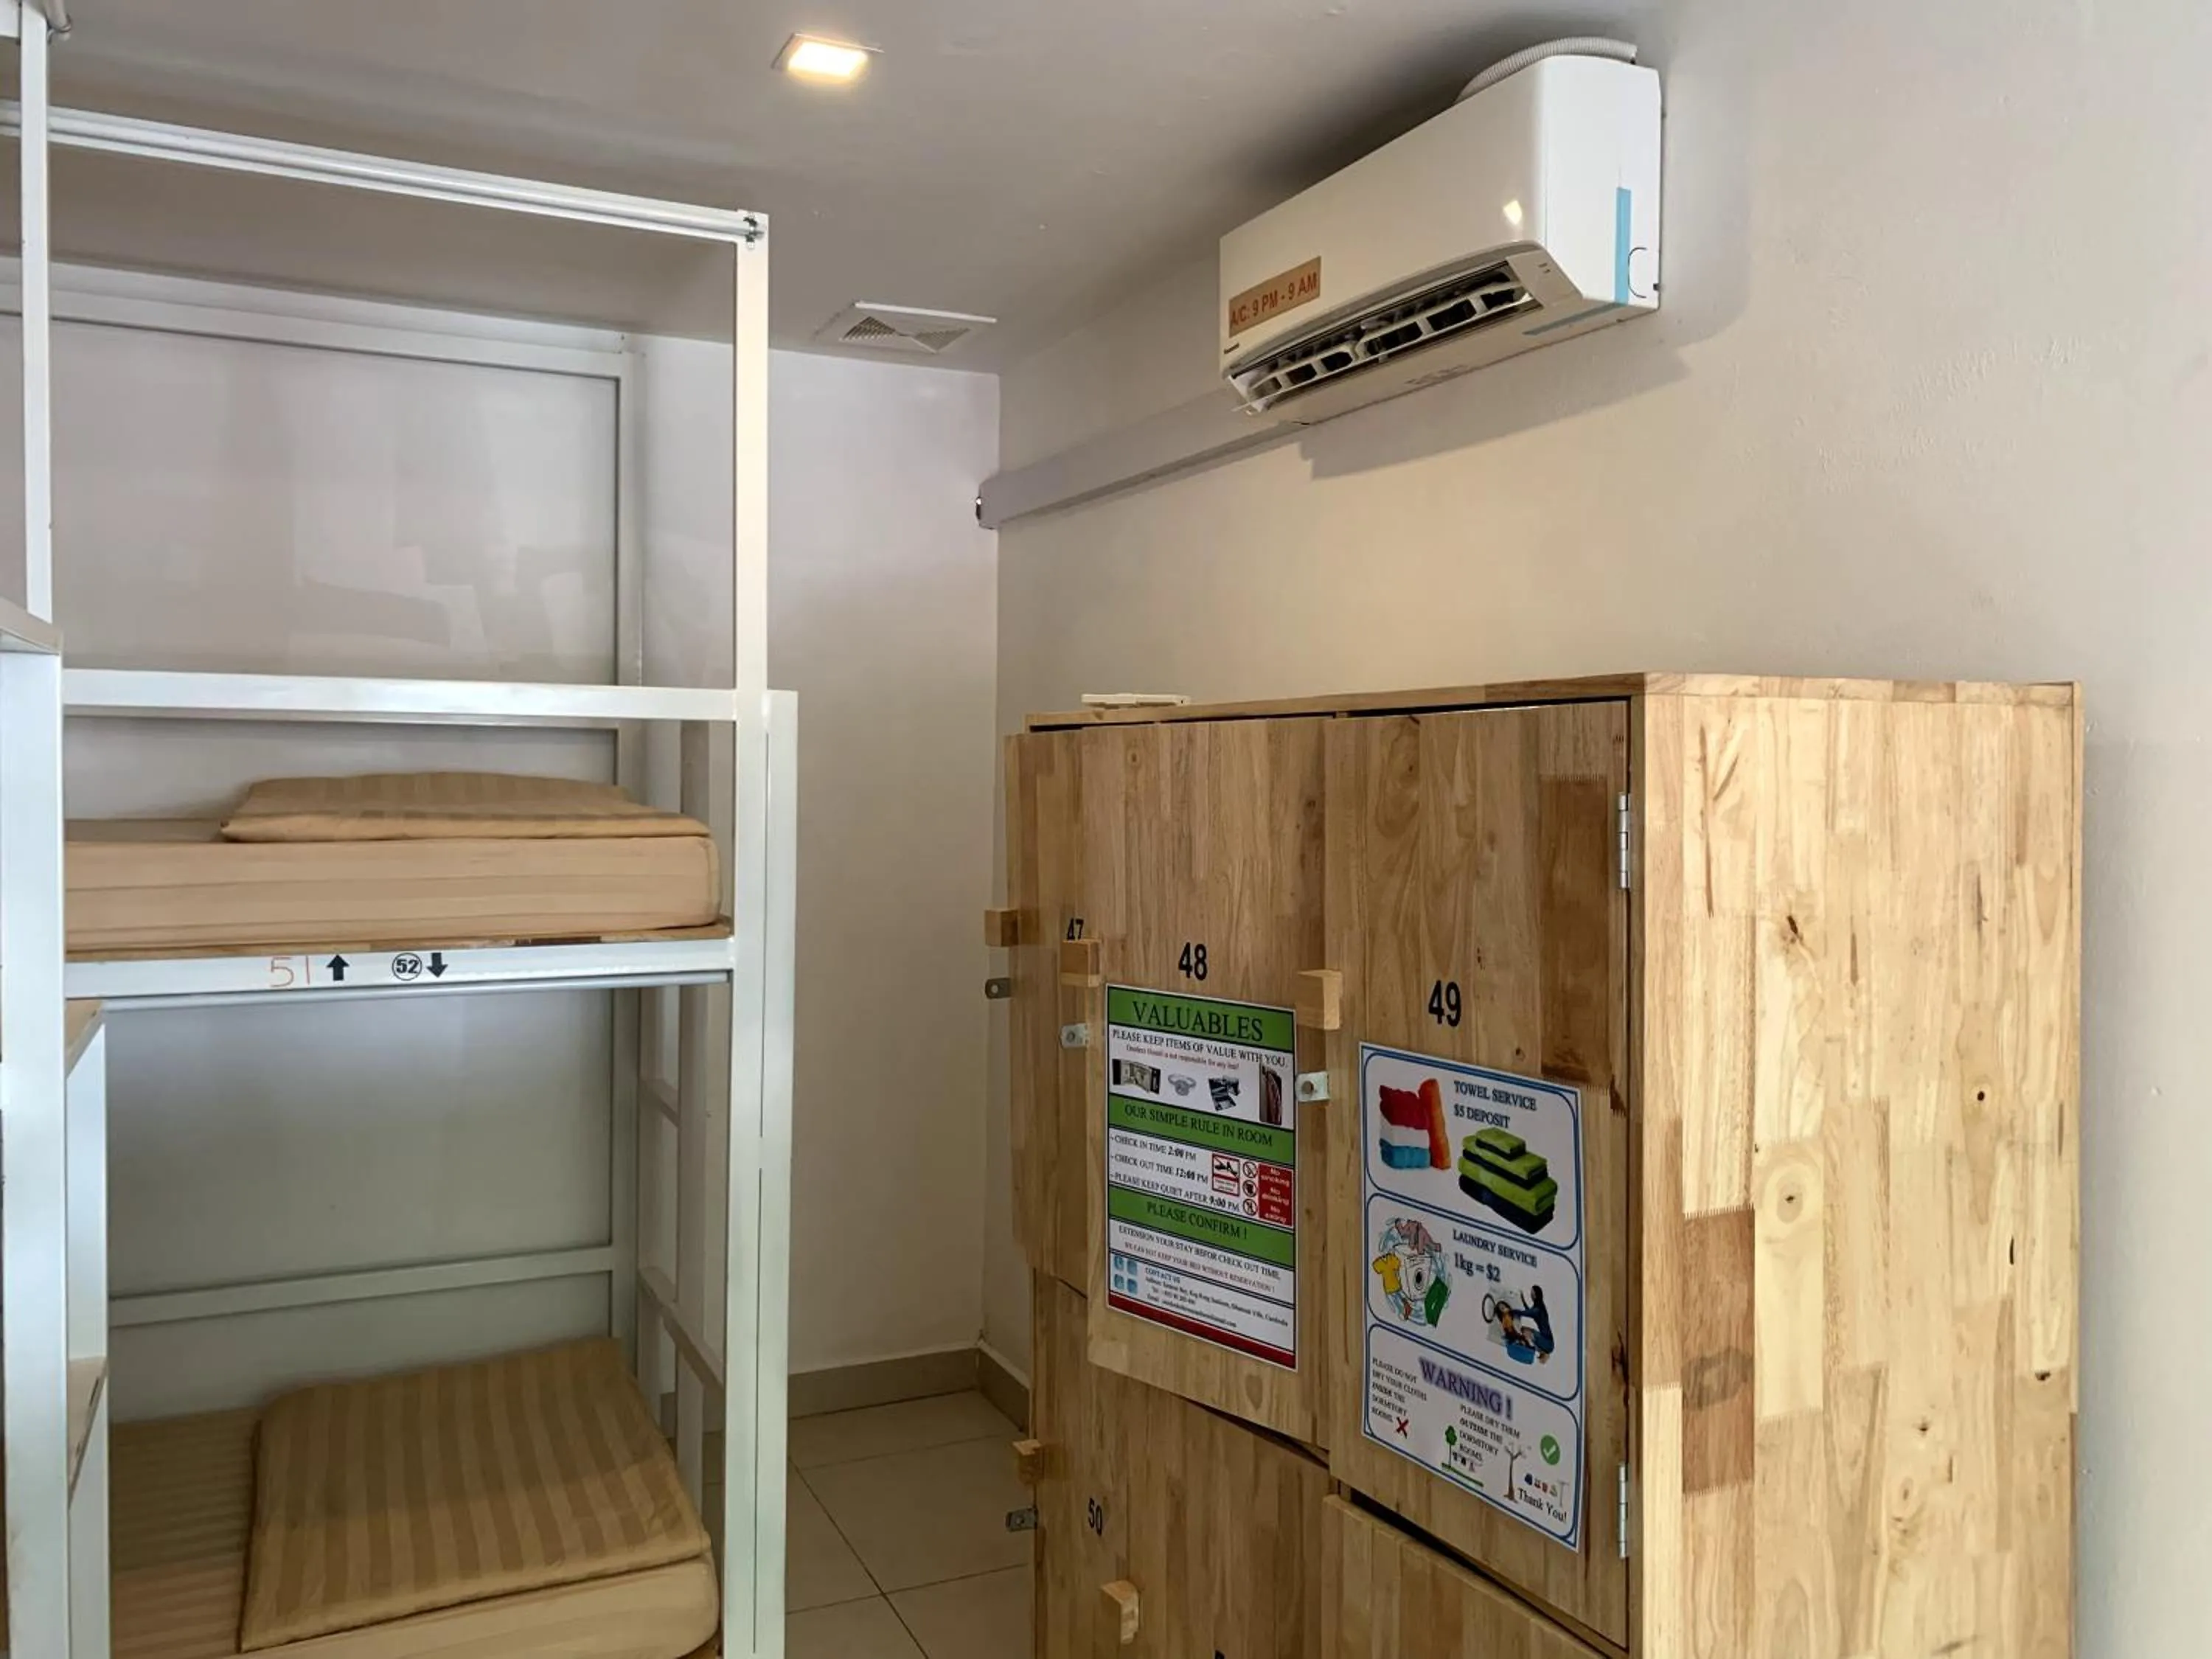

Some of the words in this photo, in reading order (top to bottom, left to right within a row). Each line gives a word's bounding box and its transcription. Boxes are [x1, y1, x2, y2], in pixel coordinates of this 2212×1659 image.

[1252, 299, 1259, 317] 9
[1262, 290, 1279, 313] PM
[1288, 282, 1295, 300] 9
[1298, 272, 1318, 296] AM
[1066, 918, 1084, 941] 47
[270, 955, 310, 988] 51
[396, 959, 419, 974] 52
[1178, 942, 1208, 981] 48
[1132, 1000, 1263, 1043] VALUABLES
[1428, 980, 1462, 1027] 49
[1113, 1028, 1140, 1042] PLEASE
[1144, 1033, 1164, 1046] KEEP
[1166, 1037, 1191, 1051] ITEMS
[1192, 1041, 1203, 1053] OF
[1207, 1043, 1237, 1059] VALUE
[1239, 1049, 1262, 1063] WITH
[1454, 1079, 1489, 1101] TOWEL
[1492, 1088, 1537, 1112] SERVICE
[1124, 1102, 1147, 1120] OUR
[1150, 1108, 1187, 1129] SIMPLE
[1191, 1117, 1220, 1135] RULE
[1222, 1124, 1234, 1139] IN
[1237, 1127, 1272, 1147] ROOM
[1454, 1102, 1464, 1118] $5
[1467, 1105, 1510, 1130] DEPOSIT
[1114, 1134, 1137, 1147] CHECK
[1140, 1140, 1147, 1150] IN
[1149, 1142, 1166, 1154] TIME
[1167, 1147, 1183, 1158] 2:00
[1185, 1150, 1196, 1161] PM
[1114, 1152, 1137, 1166] CHECK
[1139, 1158, 1153, 1170] OUT
[1156, 1162, 1172, 1175] TIME
[1175, 1166, 1194, 1180] 12:00
[1197, 1172, 1208, 1184] PM
[1114, 1170, 1140, 1186] PLEASE
[1141, 1178, 1158, 1191] KEEP
[1160, 1182, 1181, 1197] QUIET
[1183, 1189, 1208, 1204] AFTER
[1209, 1195, 1225, 1208] 9:00
[1147, 1200, 1186, 1224] PLEASE
[1189, 1211, 1239, 1239] CONFIRM
[1119, 1224, 1153, 1242] EXTENSION
[1155, 1234, 1174, 1248] YOUR
[1175, 1240, 1192, 1253] STAY
[1217, 1253, 1241, 1268] CHECK
[1244, 1260, 1258, 1273] OUT
[1453, 1228, 1495, 1254] LAUNDRY
[1498, 1243, 1537, 1268] SERVICE
[1454, 1251, 1473, 1277] 1kg
[1486, 1261, 1500, 1284] $2
[1418, 1356, 1502, 1416] WARNING
[1460, 1402, 1483, 1422] PLEASE
[1501, 1422, 1520, 1440] THEM
[1459, 1429, 1498, 1457] DORMITORY
[1088, 1498, 1102, 1537] 50
[1517, 1486, 1543, 1512] Thank
[1545, 1500, 1567, 1525] You!
